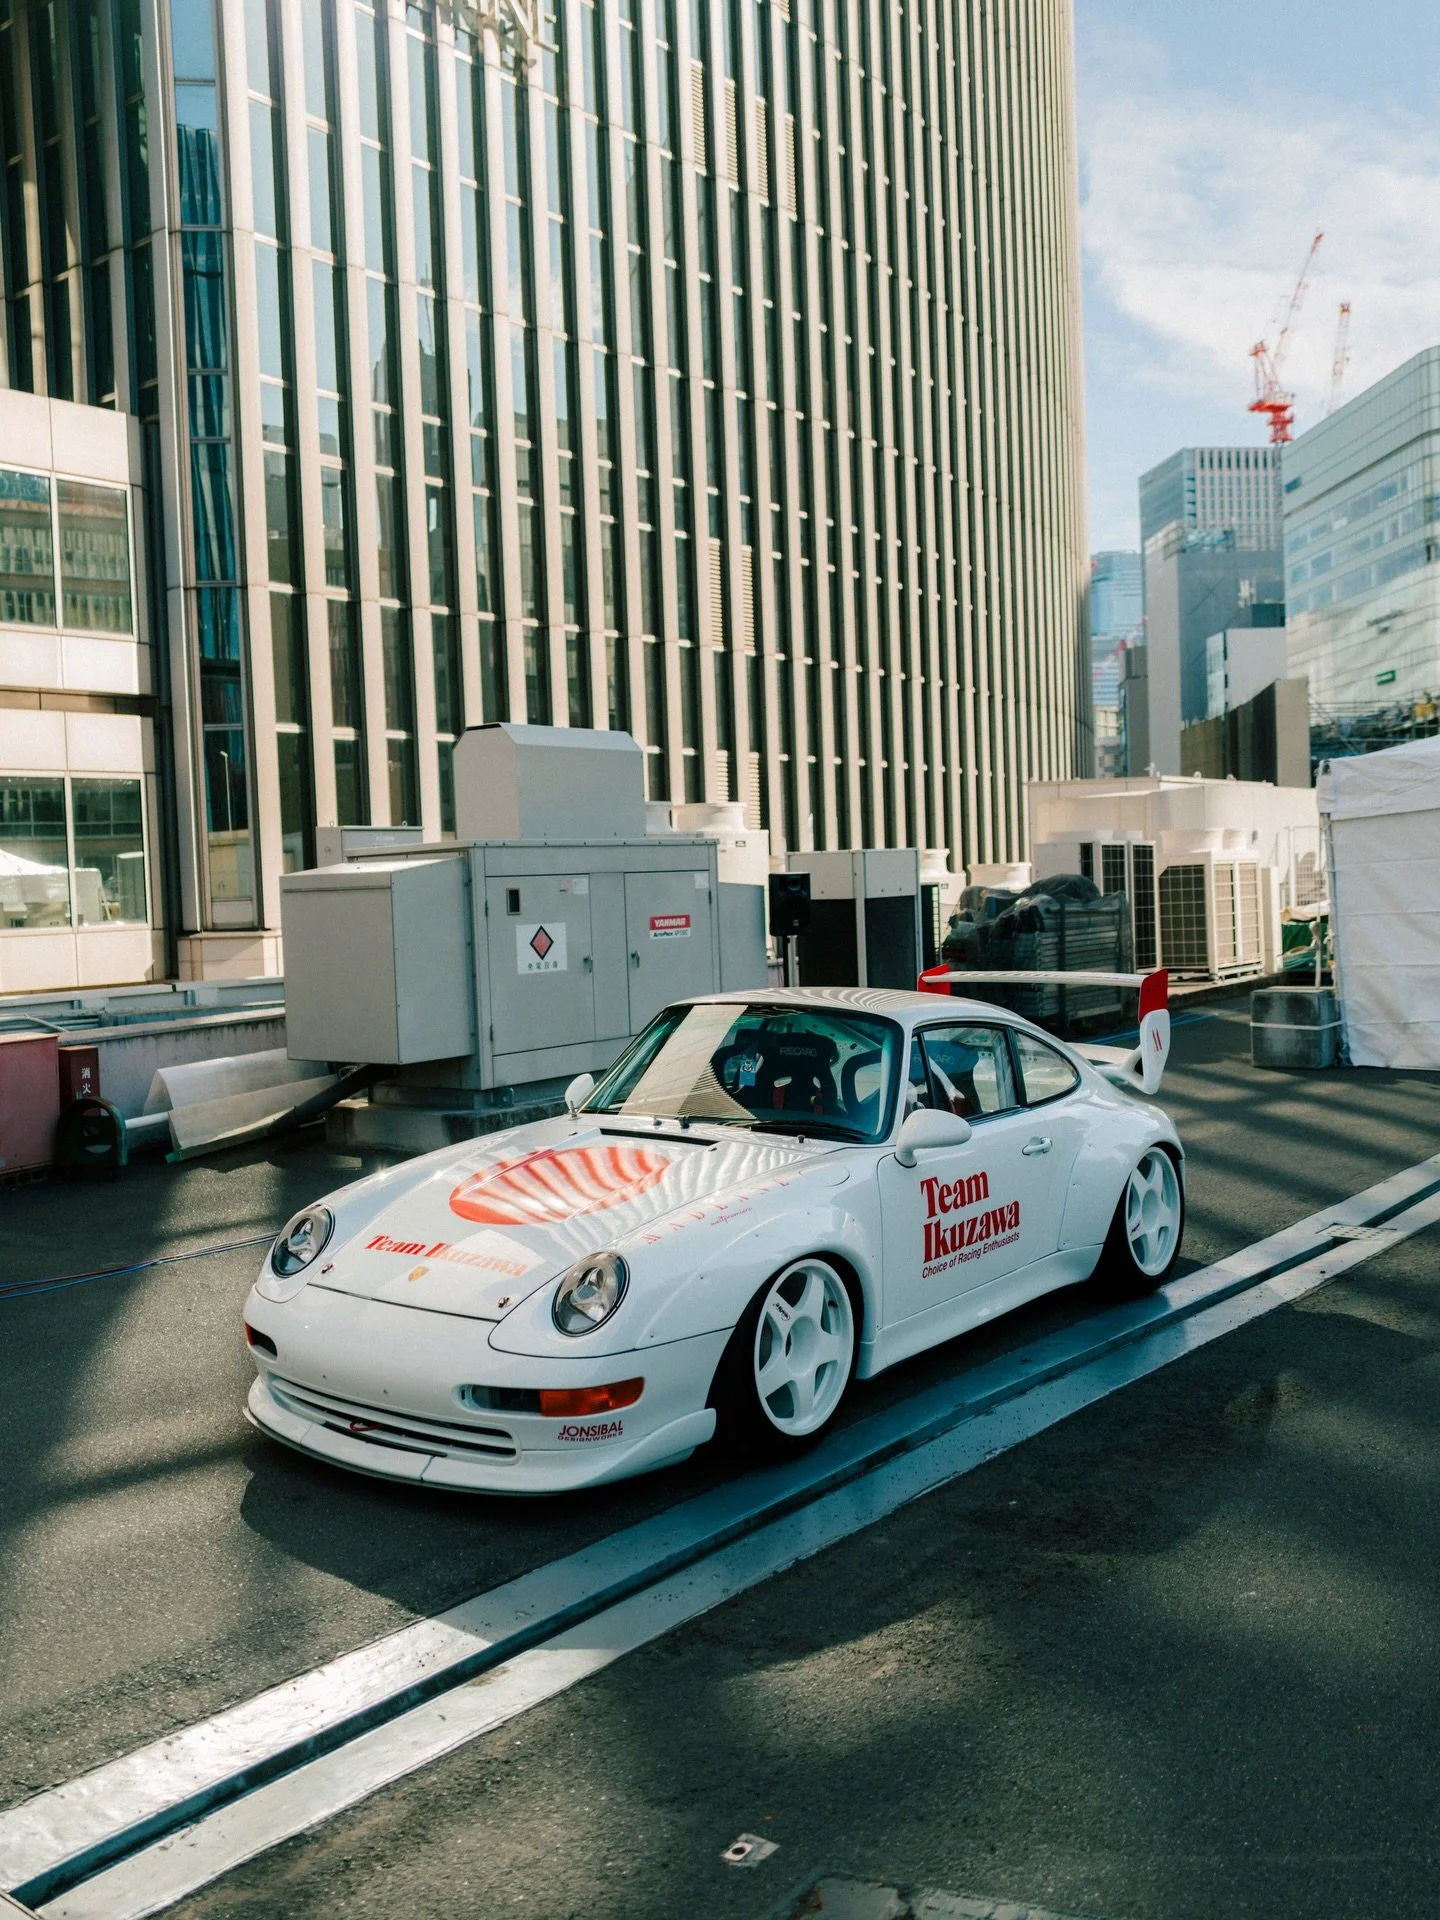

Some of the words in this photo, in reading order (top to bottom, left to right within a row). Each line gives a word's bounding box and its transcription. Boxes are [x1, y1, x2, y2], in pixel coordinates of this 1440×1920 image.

[780, 1046, 817, 1058] RECARO
[920, 1171, 990, 1219] Team
[923, 1200, 1020, 1264] Ikuzawa
[365, 1235, 427, 1255] Team
[424, 1242, 530, 1277] Ikuzawa
[922, 1262, 948, 1279] Choice
[949, 1257, 958, 1268] of
[957, 1248, 981, 1265] Racing
[982, 1232, 1020, 1254] Enthusiasts
[559, 1420, 624, 1437] JONSIBAL
